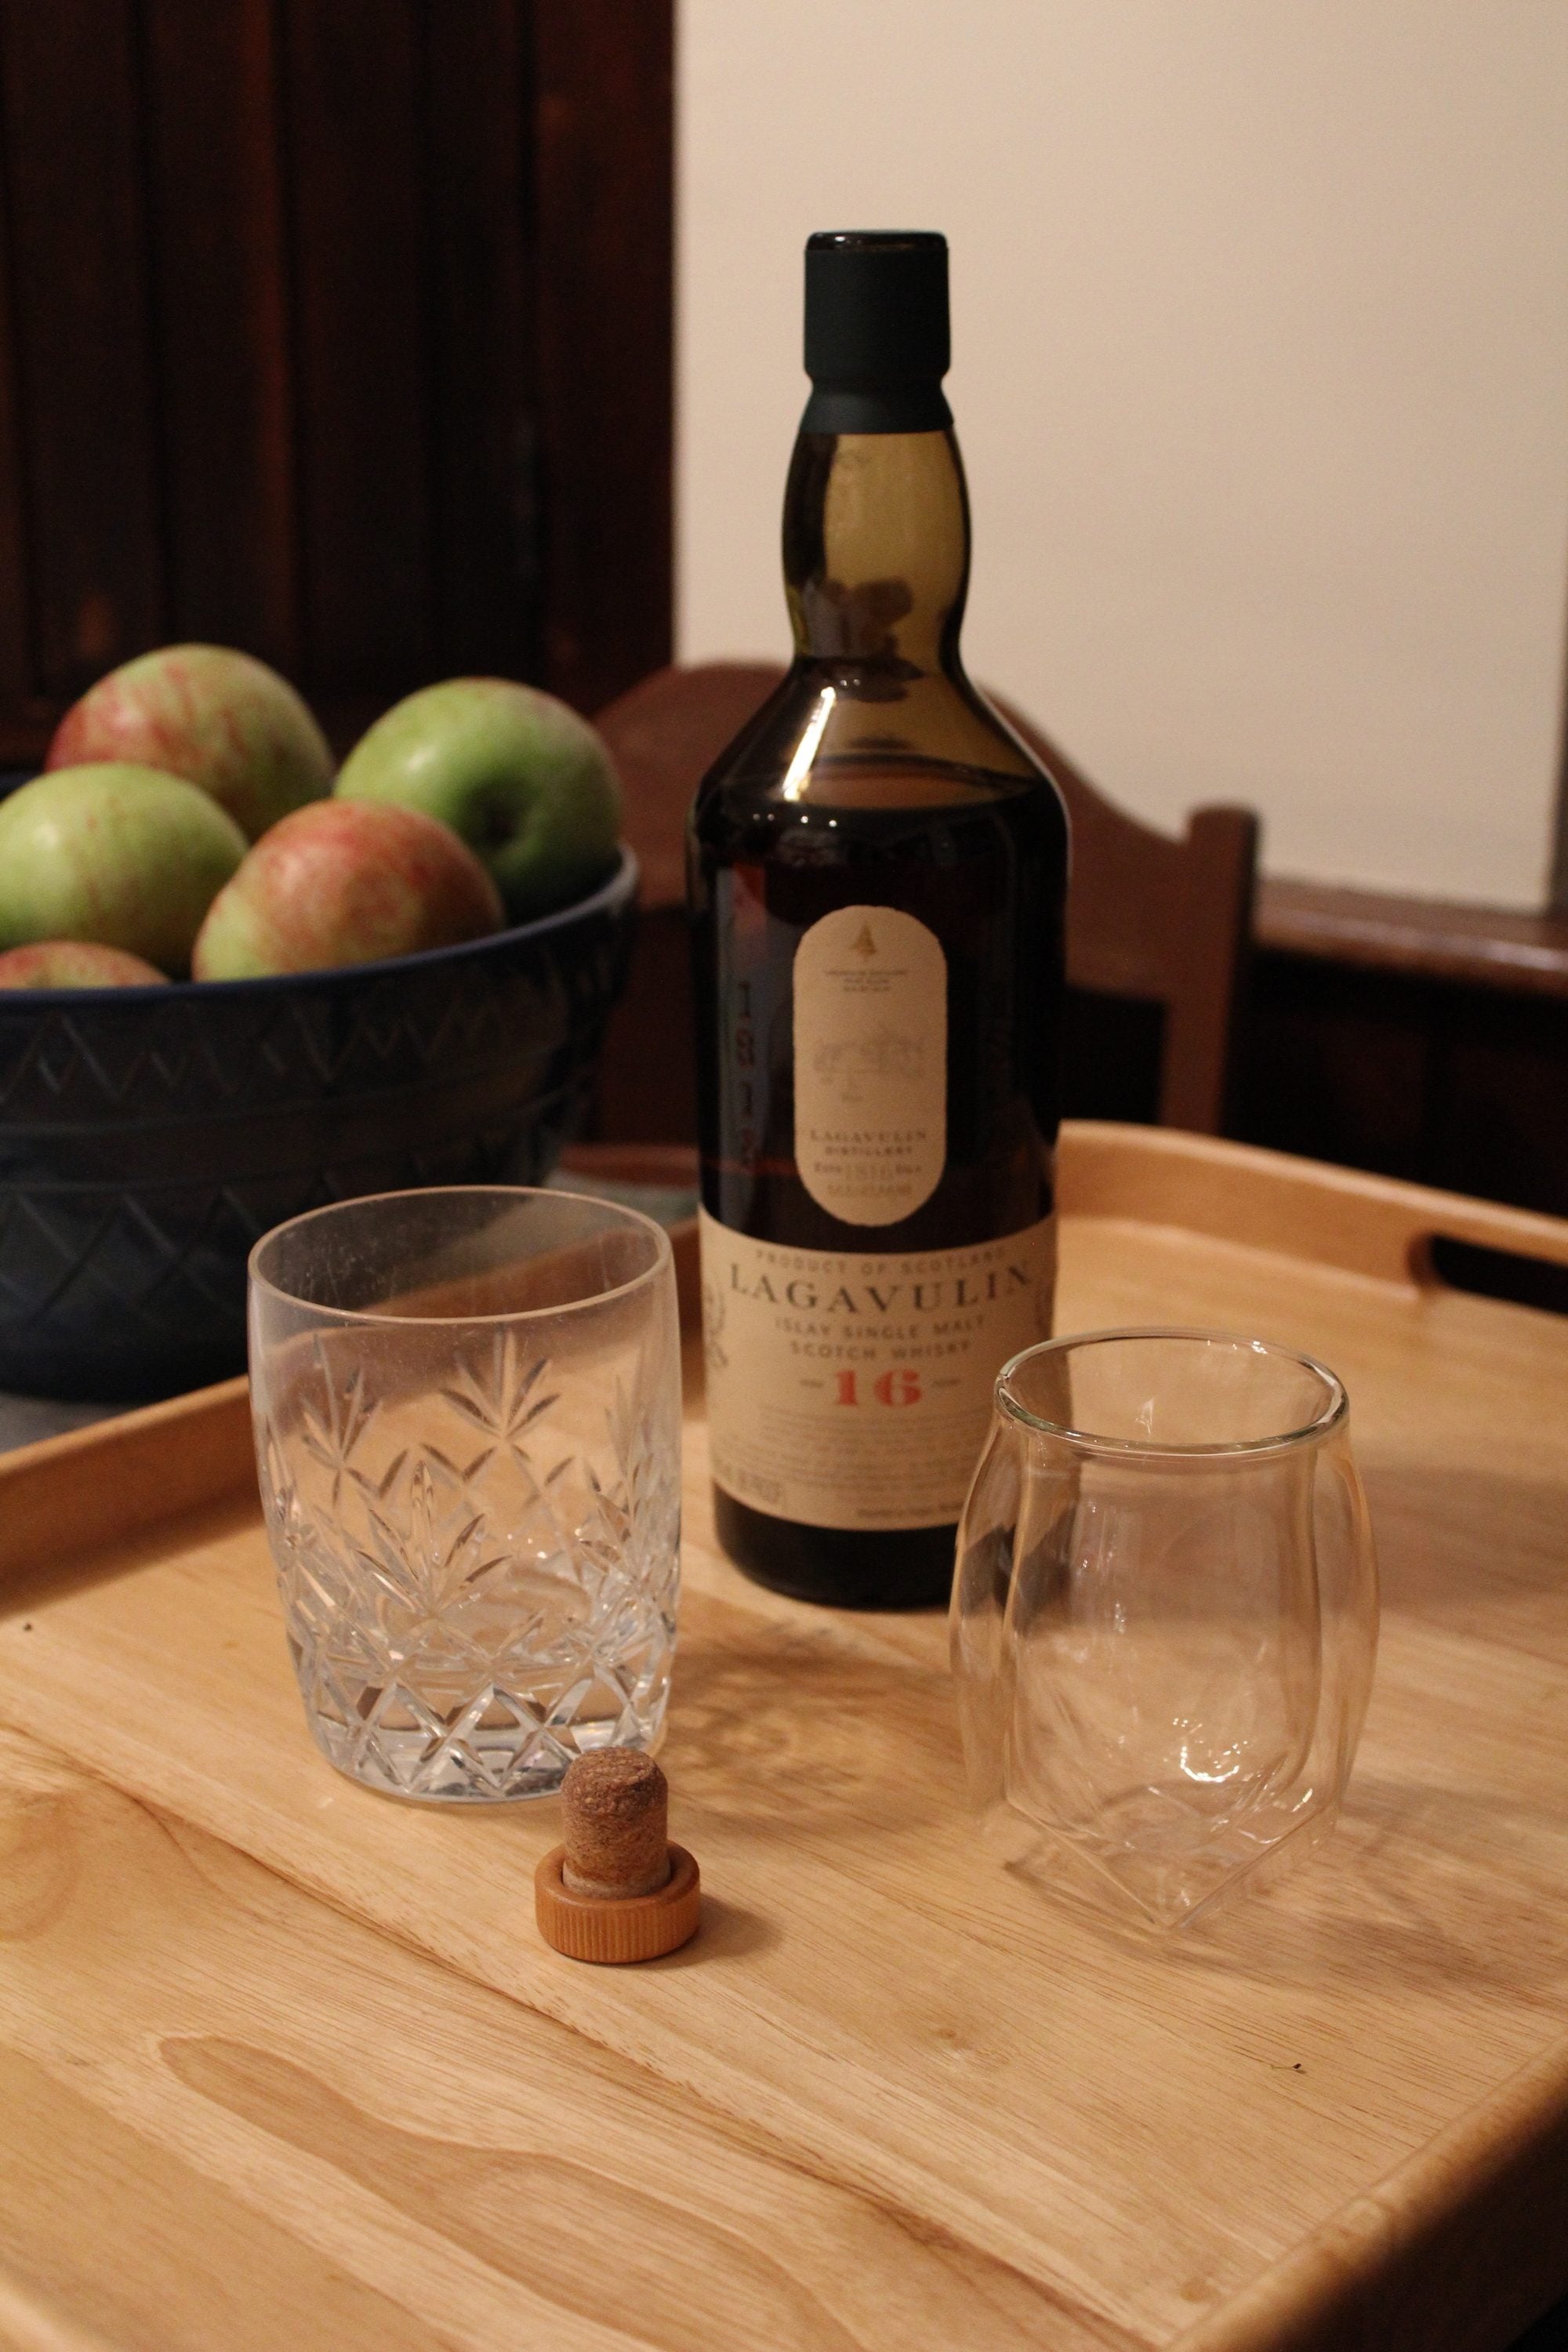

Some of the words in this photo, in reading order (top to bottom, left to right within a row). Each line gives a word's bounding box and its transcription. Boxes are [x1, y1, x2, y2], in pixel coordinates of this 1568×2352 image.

[755, 1249, 848, 1275] PRODUCT
[859, 1261, 887, 1276] OF
[729, 1261, 1033, 1314] LAGAVULIN
[775, 1317, 831, 1336] ISLAY
[843, 1324, 920, 1341] SINGLE
[932, 1314, 985, 1335] MALT
[789, 1340, 877, 1361] SCOTCH
[890, 1338, 971, 1360] WHISKY
[833, 1367, 924, 1408] 16
